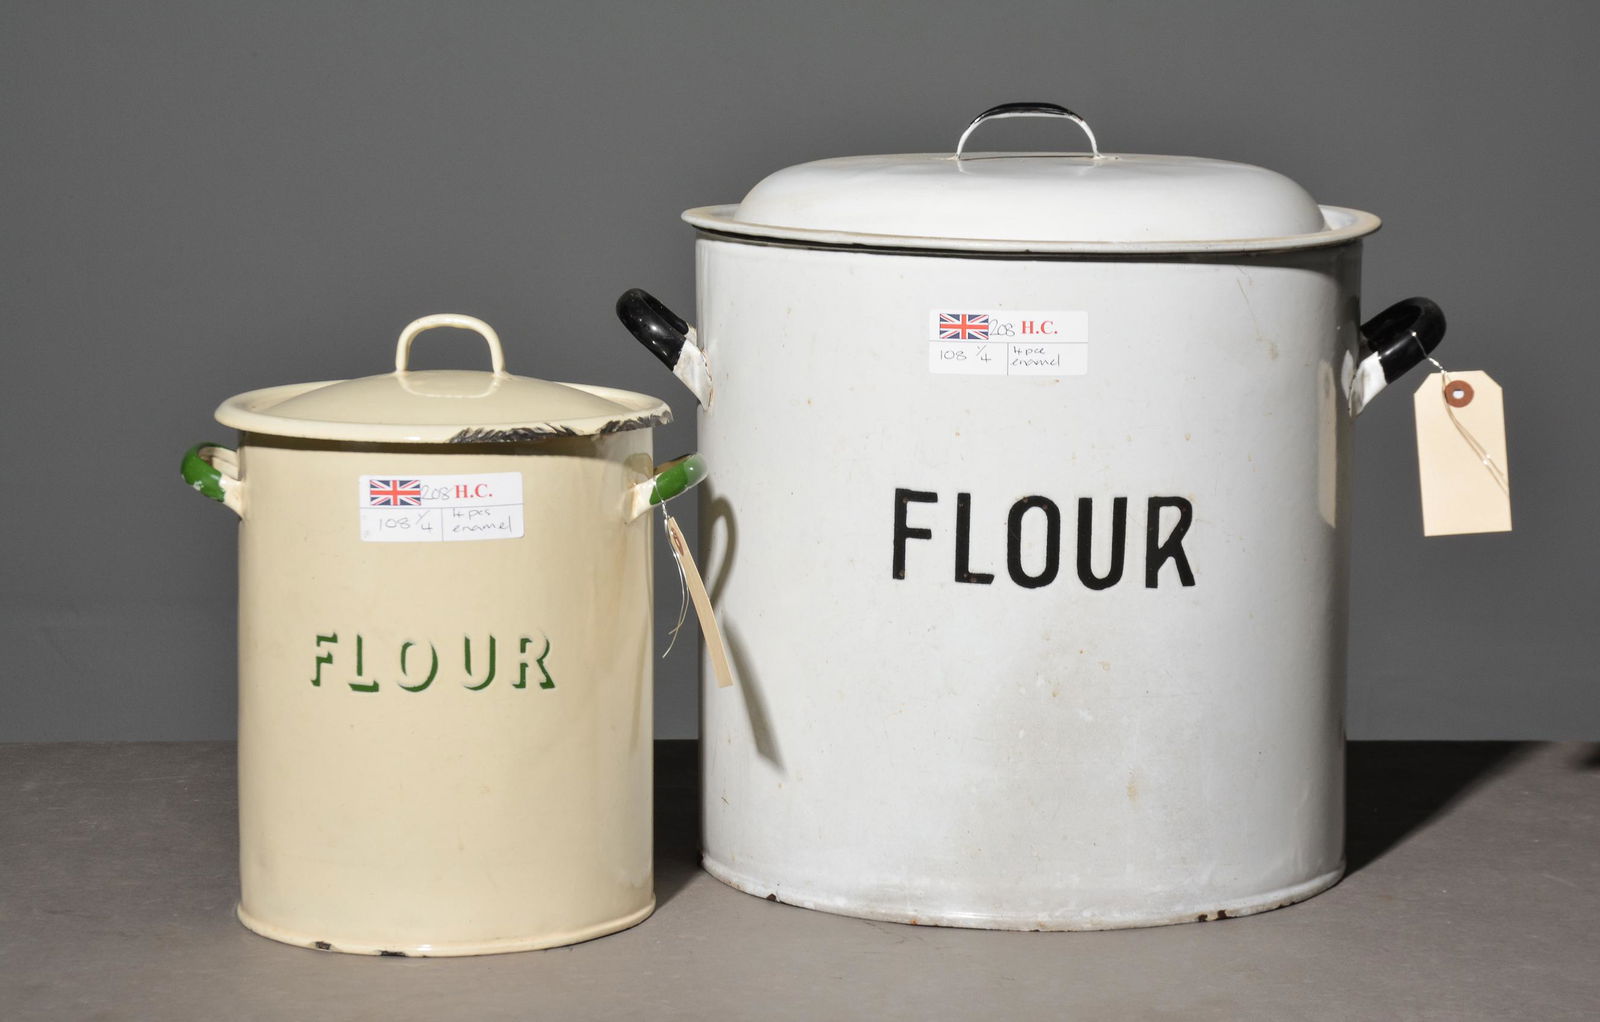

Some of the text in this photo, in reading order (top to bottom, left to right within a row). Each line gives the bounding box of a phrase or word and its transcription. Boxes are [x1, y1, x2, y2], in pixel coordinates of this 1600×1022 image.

[1021, 320, 1058, 335] H.C.
[940, 349, 967, 361] 108
[1010, 354, 1060, 367] enamel
[455, 483, 494, 499] H.C.
[378, 517, 411, 531] 108
[452, 515, 512, 533] enamel
[892, 487, 1196, 591] FLOUR
[310, 628, 556, 693] FLOUR
